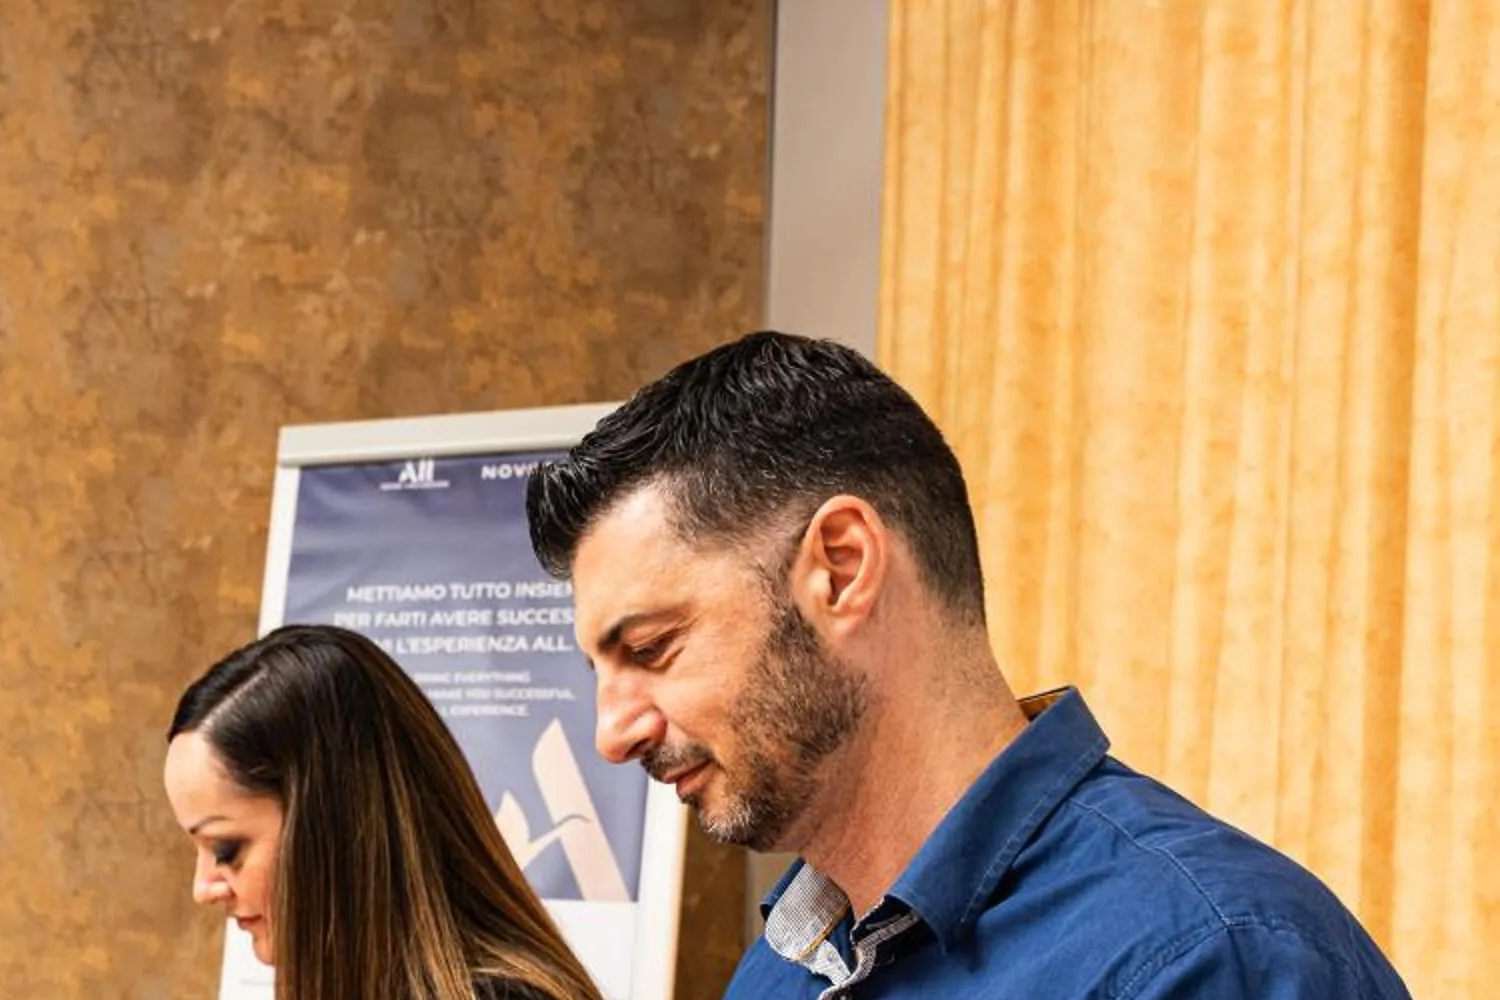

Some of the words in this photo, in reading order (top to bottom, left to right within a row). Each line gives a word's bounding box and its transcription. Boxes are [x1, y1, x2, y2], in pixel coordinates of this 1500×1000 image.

[346, 584, 447, 602] METTIAMO
[451, 582, 511, 600] TUTTO
[514, 581, 573, 599] INSIE
[333, 611, 372, 627] PER
[375, 611, 426, 628] FARTI
[430, 610, 493, 626] AVERE
[396, 636, 525, 655] L'ESPERIENZA
